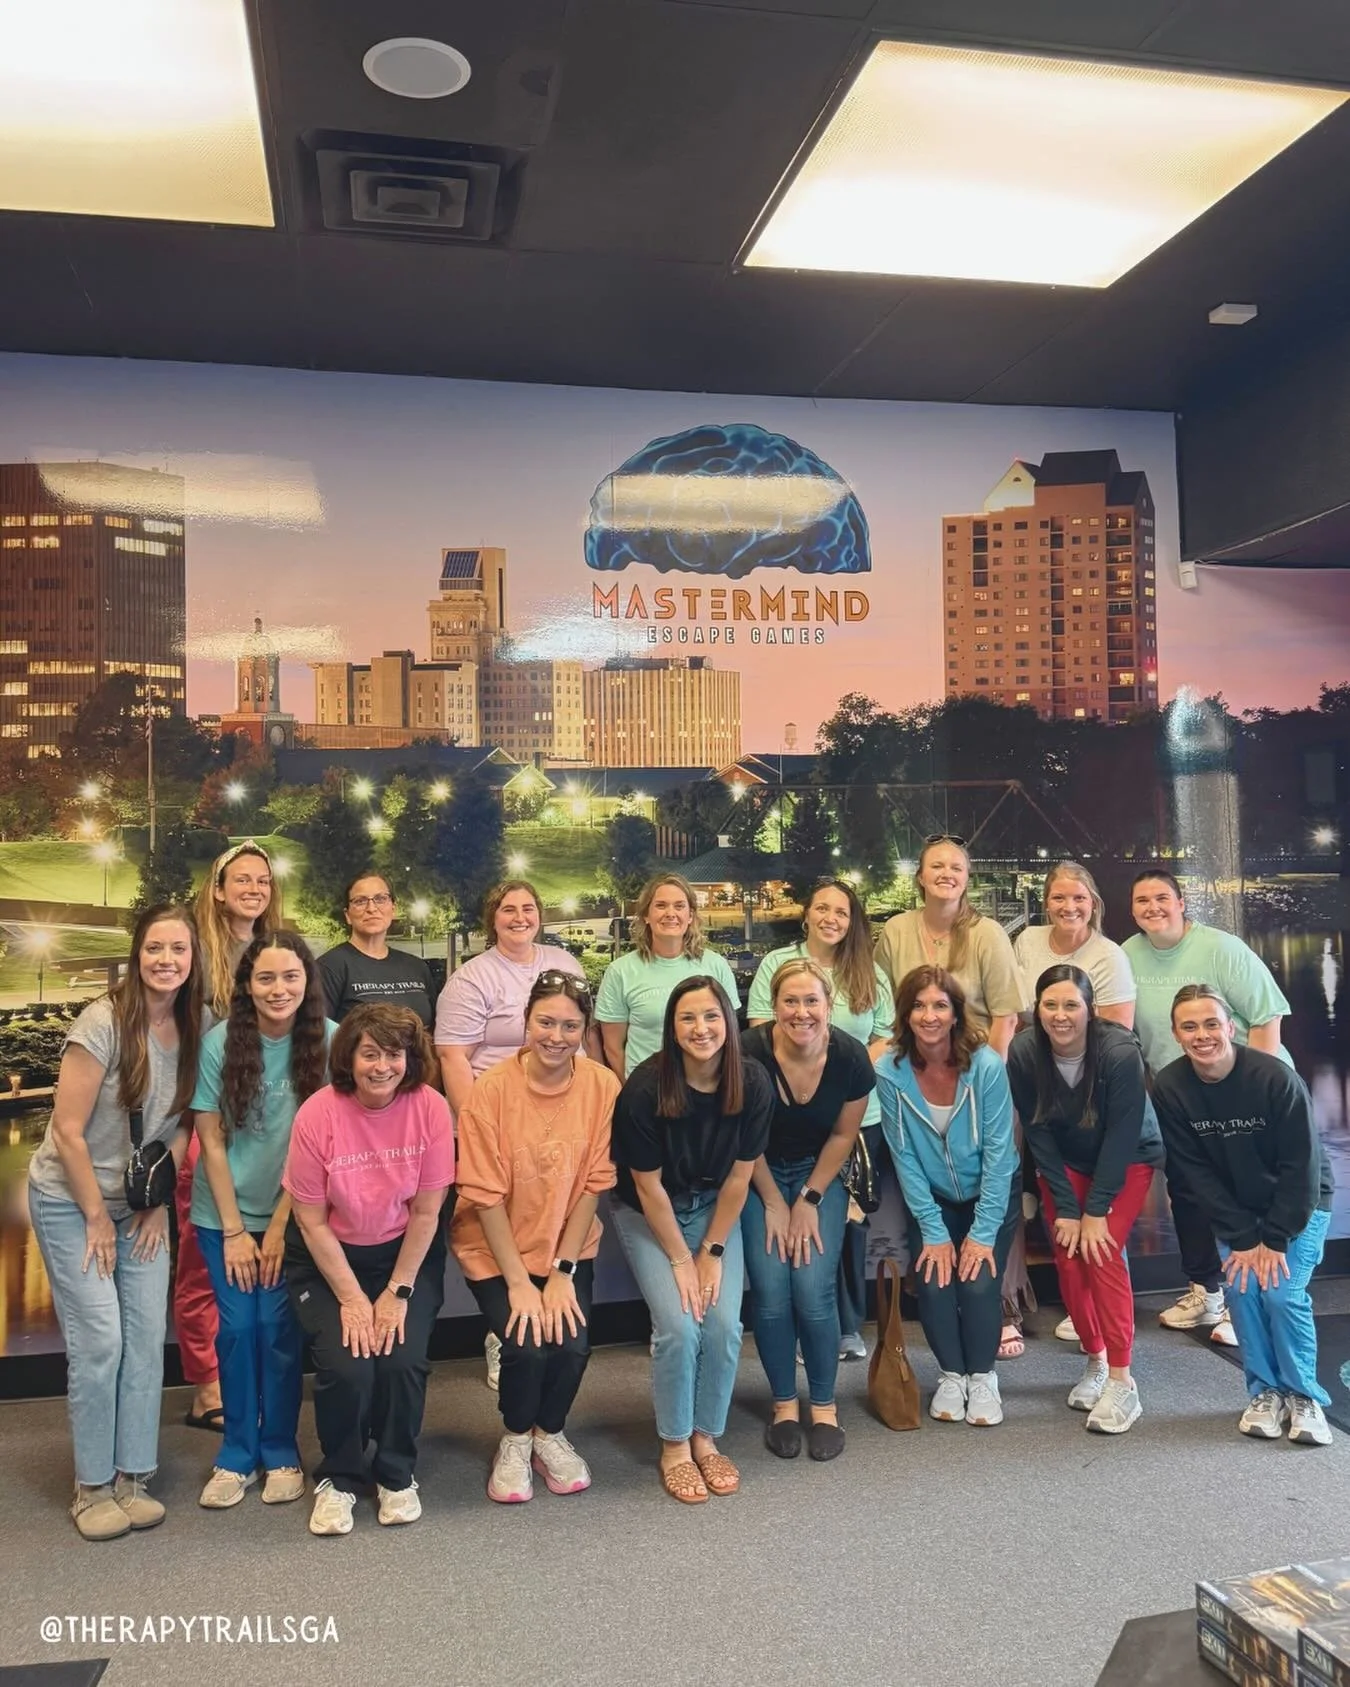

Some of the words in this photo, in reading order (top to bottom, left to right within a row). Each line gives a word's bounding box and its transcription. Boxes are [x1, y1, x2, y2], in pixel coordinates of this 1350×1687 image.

[592, 581, 870, 625] MASTERMIND
[647, 626, 735, 644] ESCAPE
[751, 627, 825, 645] GAMES
[352, 982, 395, 992] THERAPY
